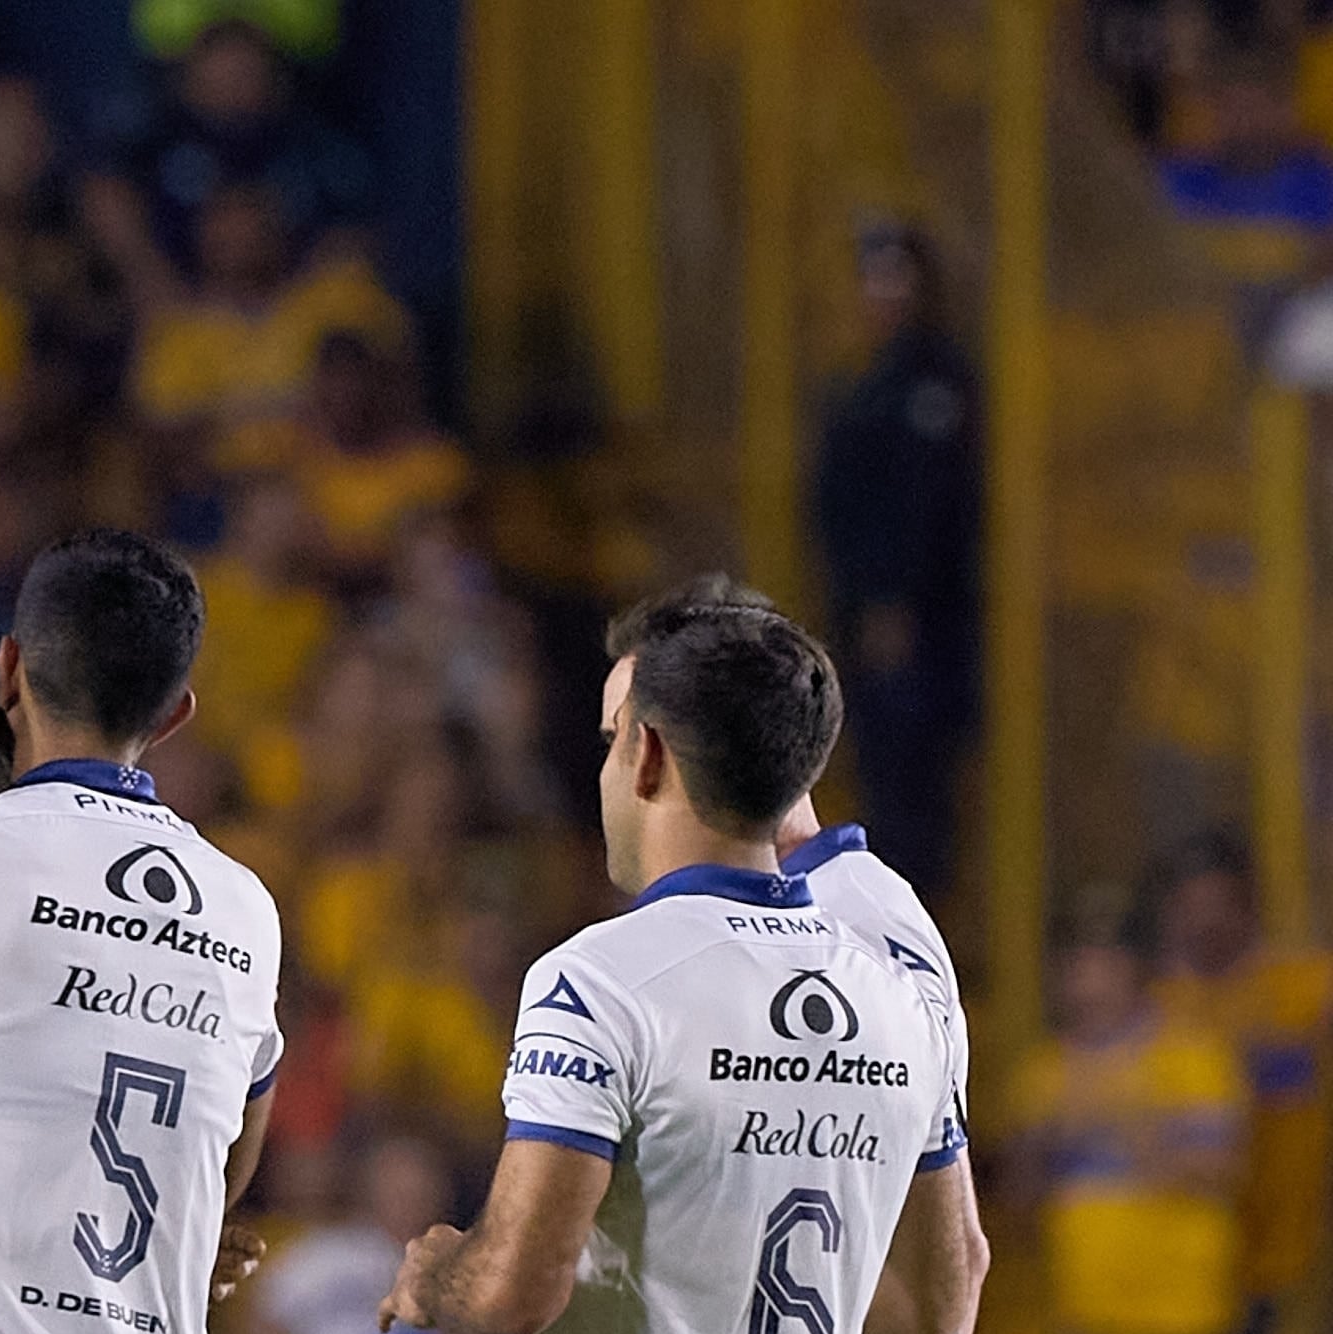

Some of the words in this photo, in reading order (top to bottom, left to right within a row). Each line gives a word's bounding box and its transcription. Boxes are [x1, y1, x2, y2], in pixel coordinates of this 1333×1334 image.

[31, 896, 148, 941] Banco
[152, 919, 251, 974] Azteca
[726, 917, 833, 934] PIRMA
[709, 1048, 810, 1082] Banco
[814, 1050, 909, 1087] Azteca
[72, 1051, 187, 1283] 5
[20, 1285, 49, 1307] D.
[56, 1292, 102, 1317] DE
[106, 1302, 168, 1334] BUEN
